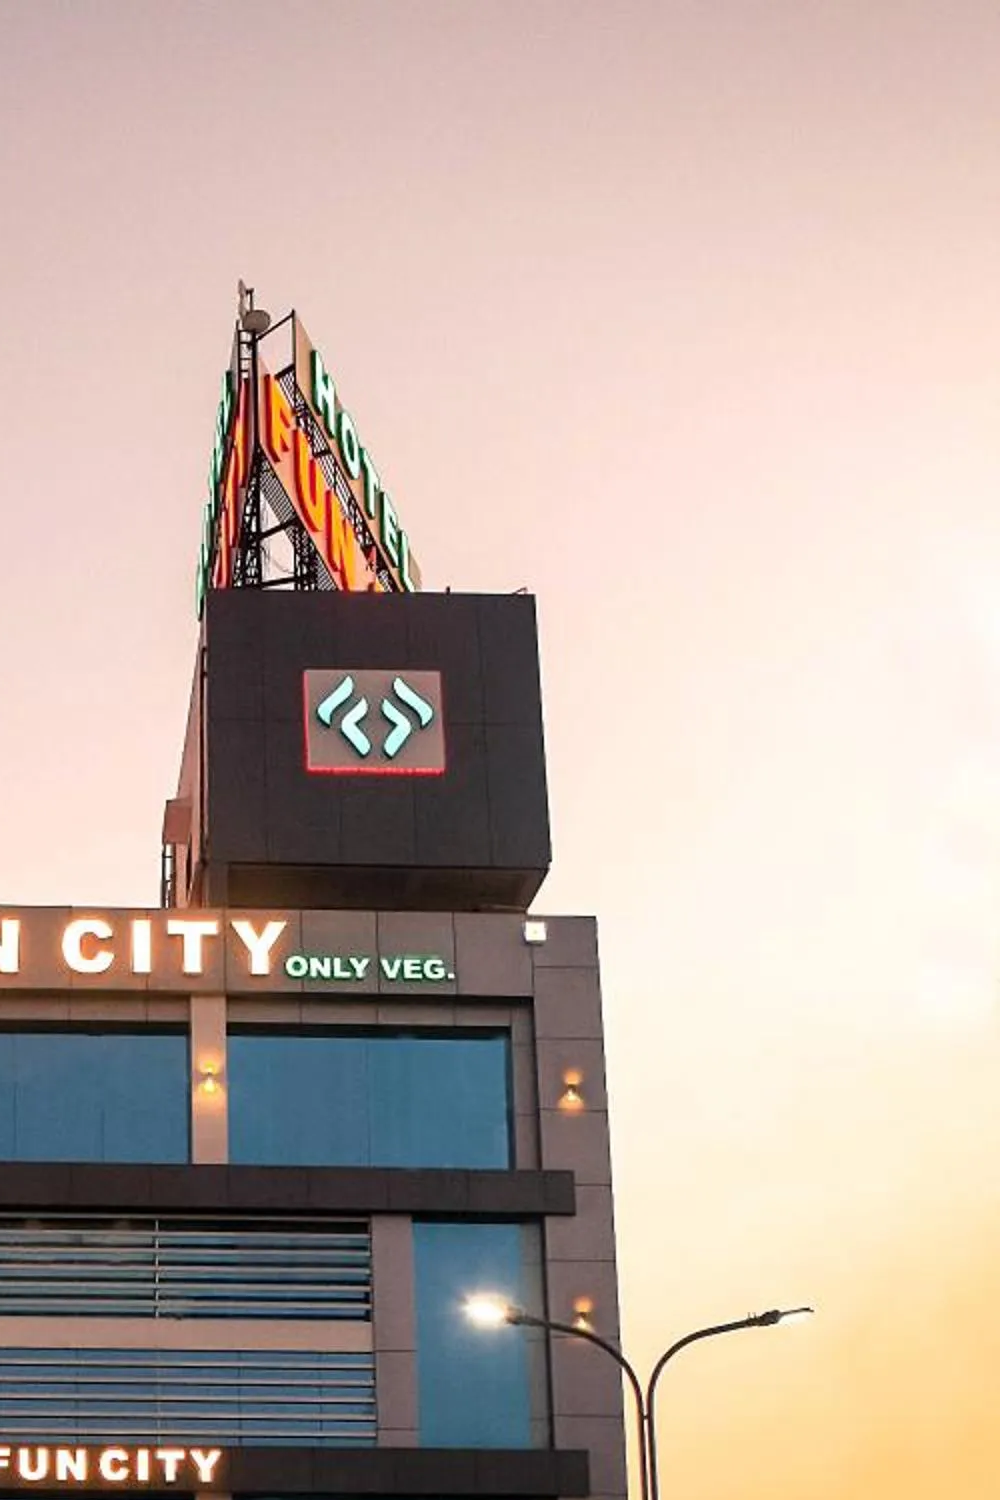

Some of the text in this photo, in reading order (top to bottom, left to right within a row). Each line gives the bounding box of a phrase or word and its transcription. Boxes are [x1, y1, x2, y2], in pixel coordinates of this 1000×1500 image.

[262, 373, 354, 592] FUN
[311, 349, 414, 592] HOTEL
[61, 919, 288, 976] CITY
[285, 955, 456, 981] ONLY VEG.
[98, 1447, 222, 1483] CITY
